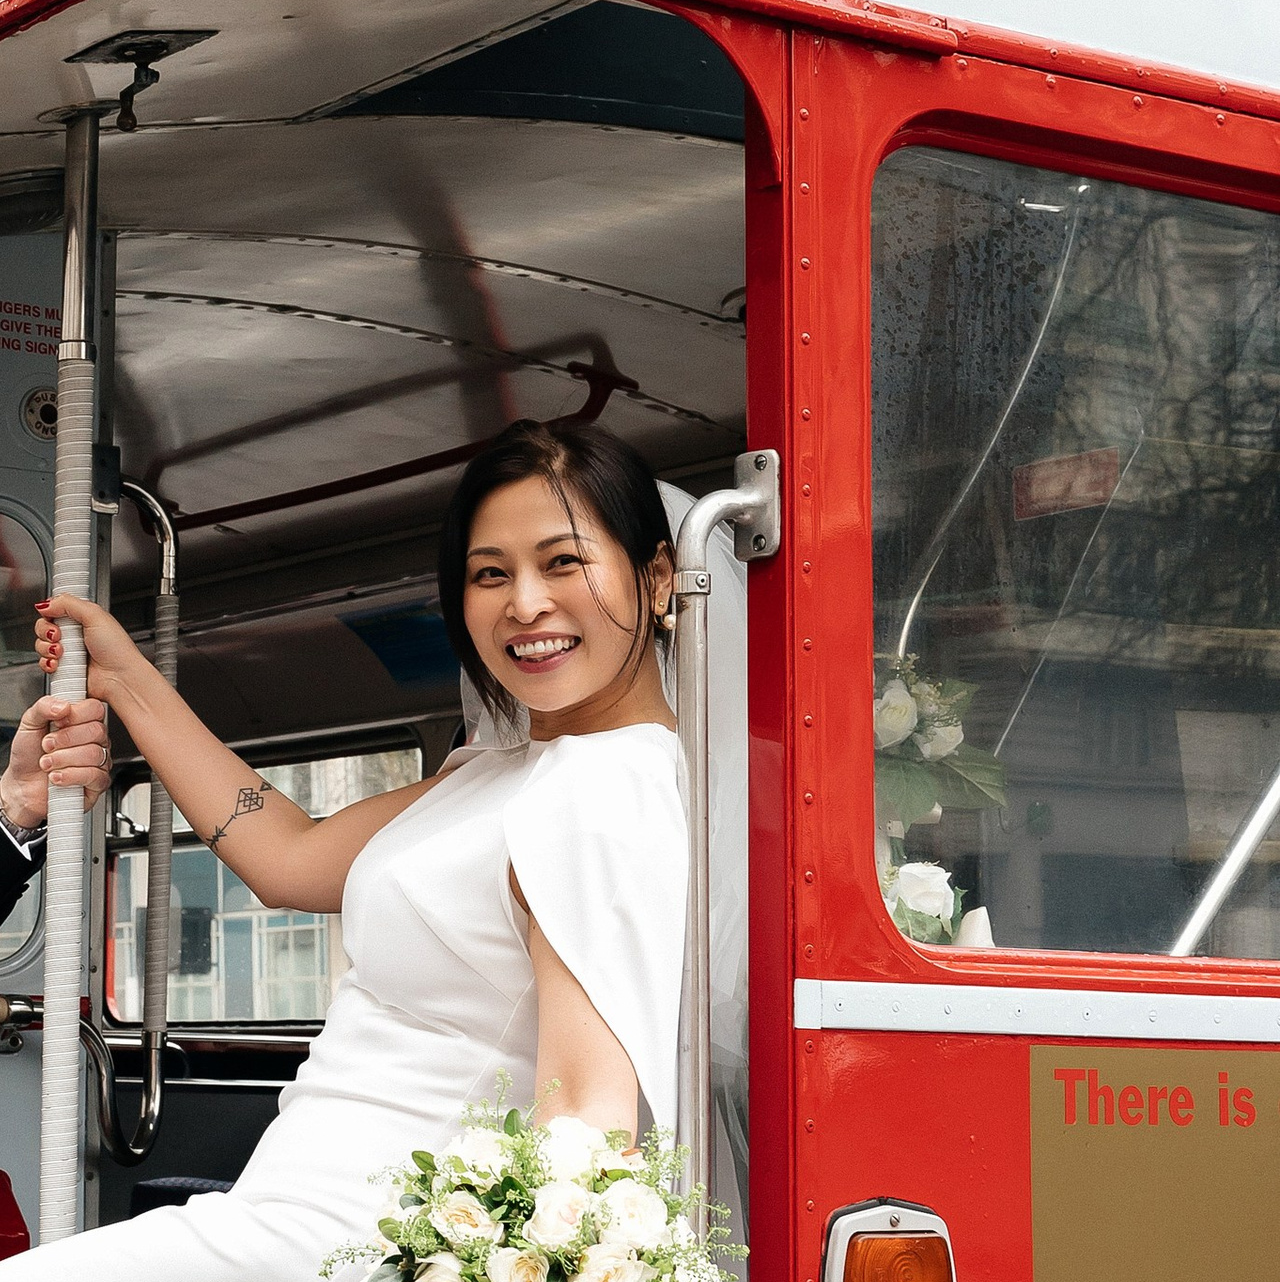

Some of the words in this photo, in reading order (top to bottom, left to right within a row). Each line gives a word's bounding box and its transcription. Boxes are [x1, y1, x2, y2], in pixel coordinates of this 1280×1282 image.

[0, 319, 32, 335] GIVE
[36, 324, 61, 338] THE
[34, 393, 58, 405] PUS
[1053, 1068, 1195, 1127] There
[1217, 1071, 1257, 1127] is
